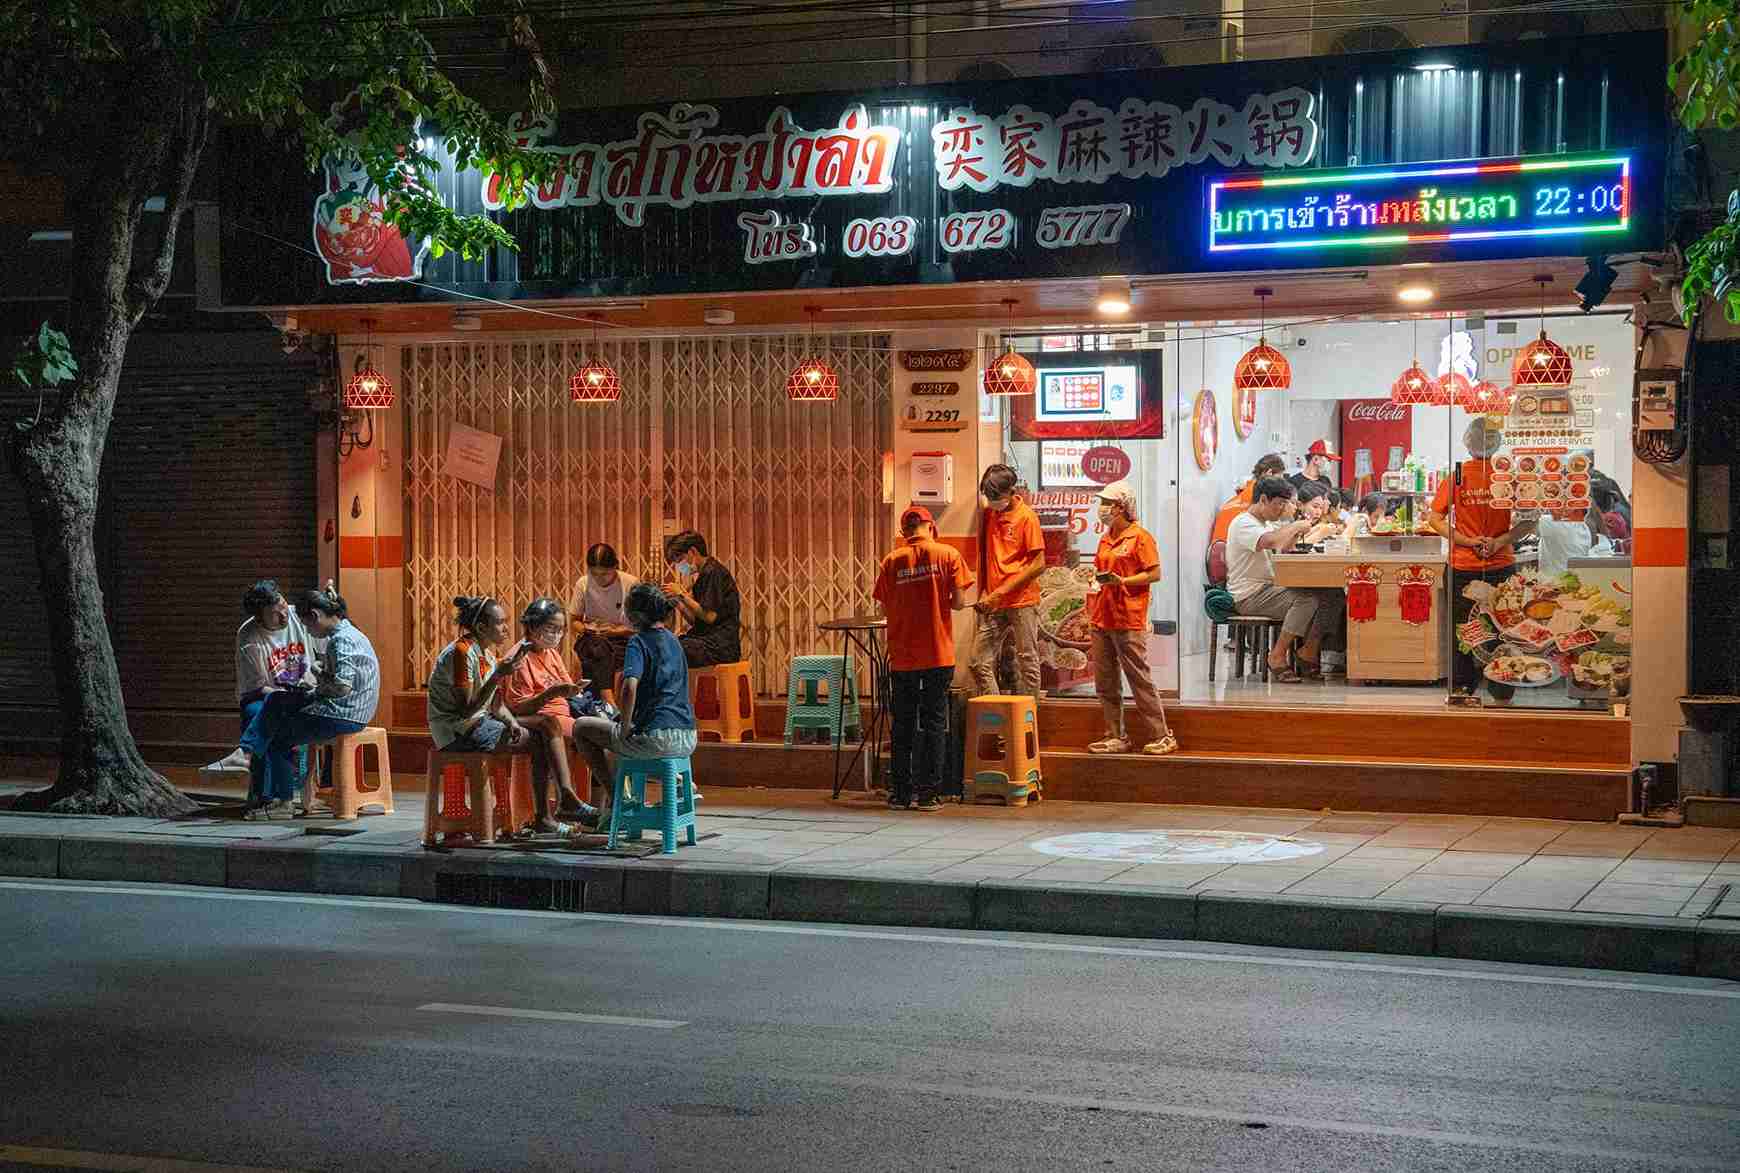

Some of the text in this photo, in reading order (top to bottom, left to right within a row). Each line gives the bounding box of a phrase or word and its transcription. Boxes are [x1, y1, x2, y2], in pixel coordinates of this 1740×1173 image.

[936, 96, 1311, 188] 奕家麻辣火锅
[1535, 184, 1625, 217] 22:00
[844, 217, 912, 255] 063
[942, 211, 1010, 251] 672
[1038, 206, 1128, 246] 5777
[920, 383, 953, 393] 2297
[926, 409, 960, 422] 2297
[1532, 438, 1557, 446] YOUR
[1558, 437, 1593, 446] SERVICE
[1089, 457, 1121, 473] OPEN
